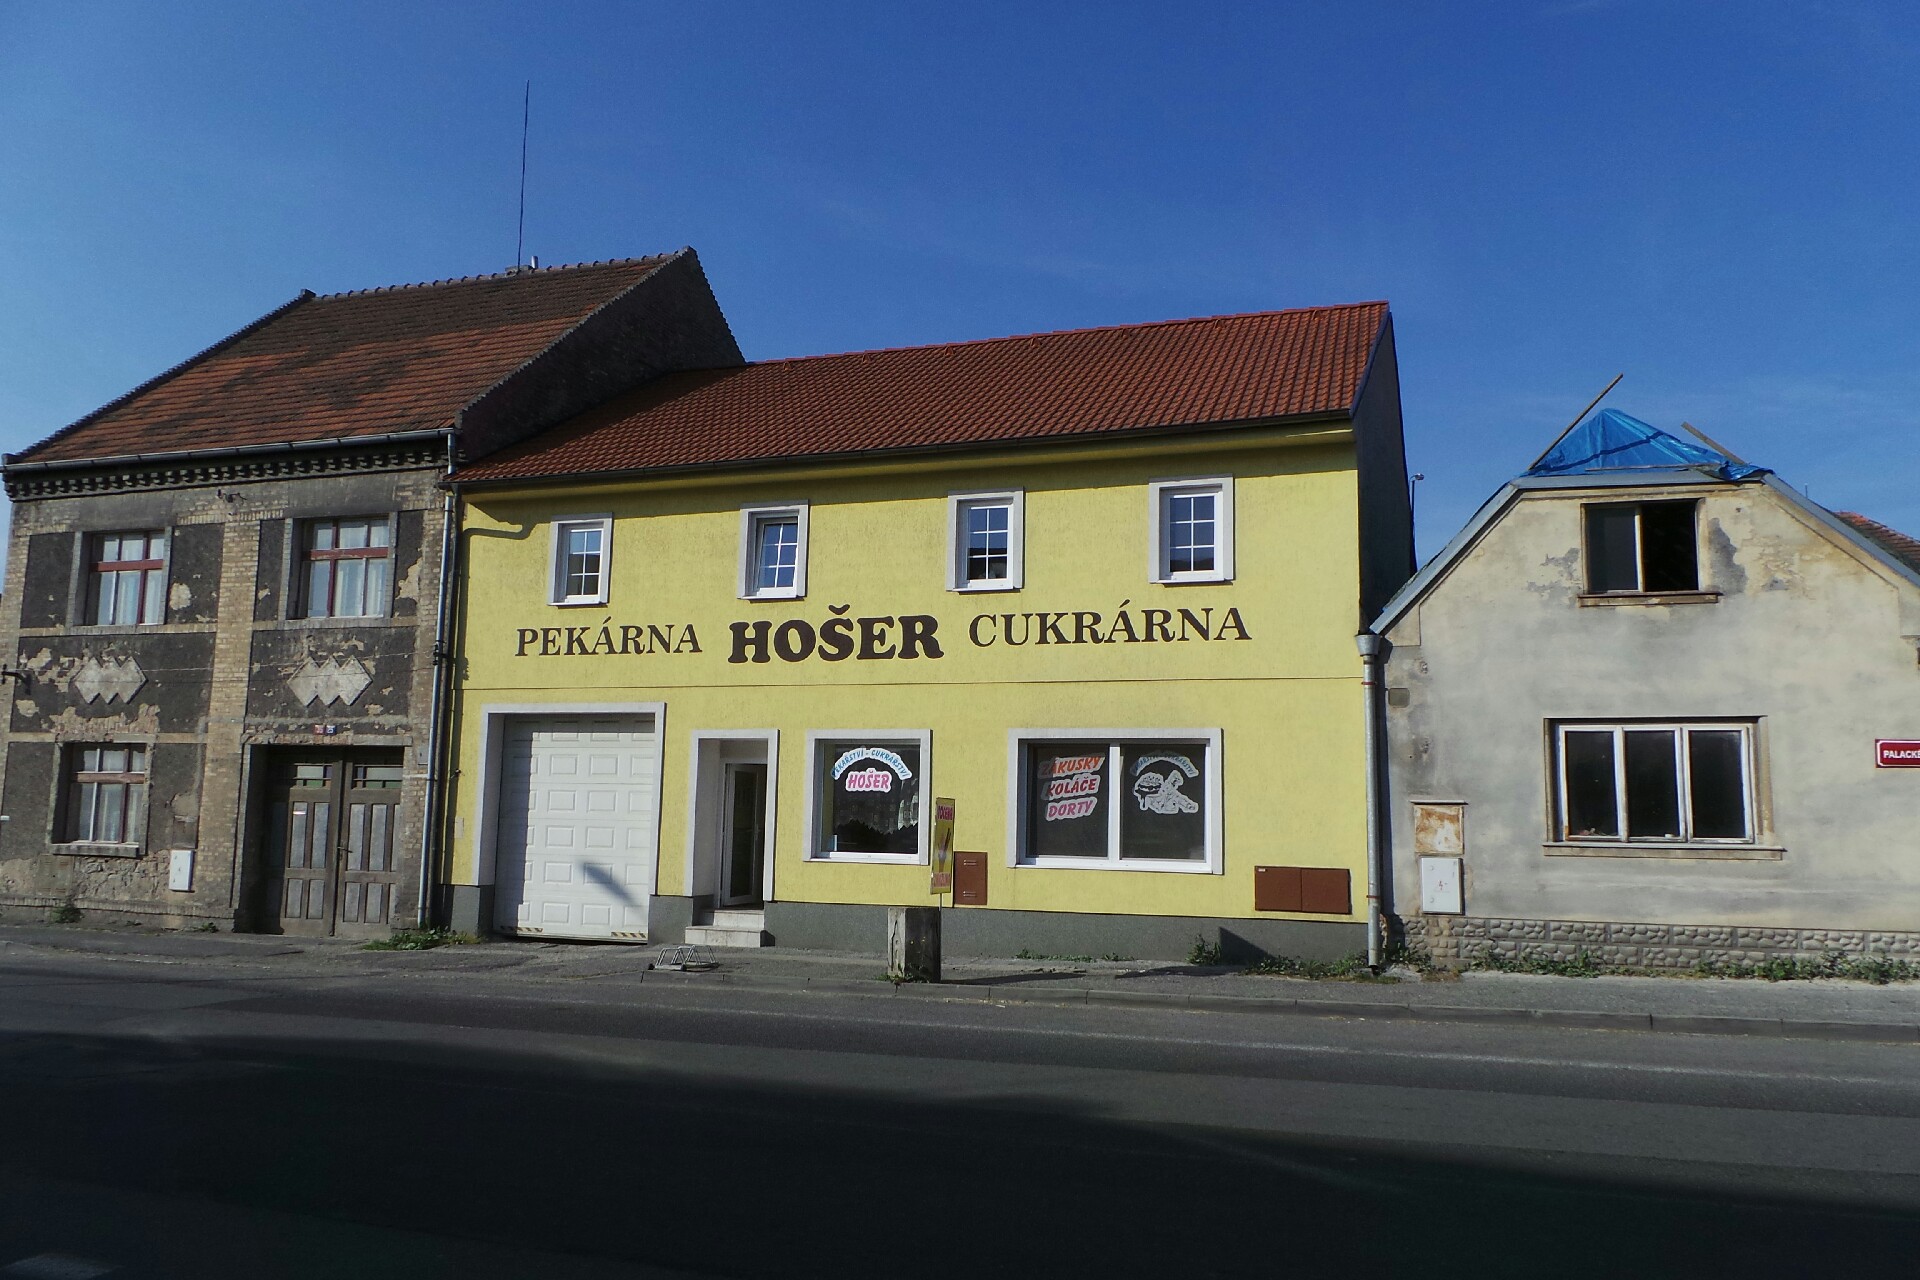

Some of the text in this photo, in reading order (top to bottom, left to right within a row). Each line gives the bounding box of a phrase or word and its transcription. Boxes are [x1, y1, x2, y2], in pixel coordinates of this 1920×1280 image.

[515, 599, 1252, 664] PEKÁRNA HOŠER CUKRÁRNA
[848, 770, 890, 789] HOŠER
[1047, 776, 1097, 797] KOLÁČE
[1048, 800, 1094, 818] DORTY
